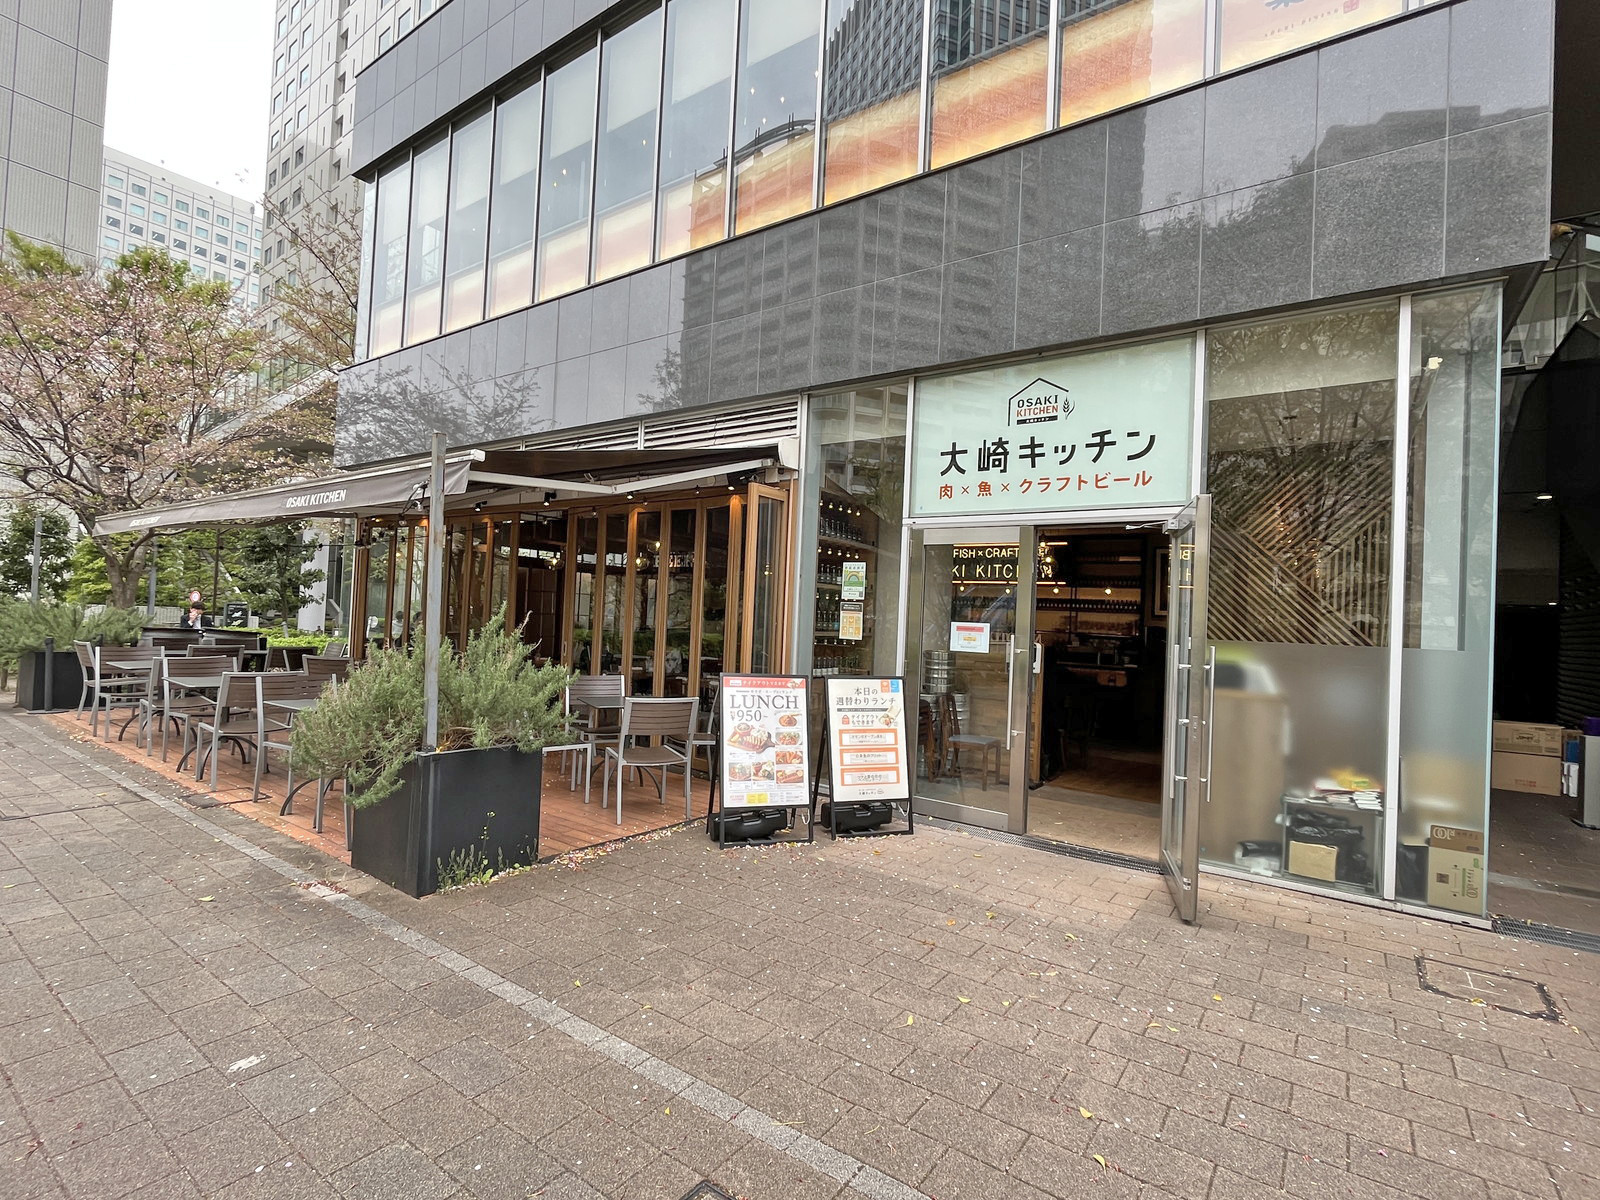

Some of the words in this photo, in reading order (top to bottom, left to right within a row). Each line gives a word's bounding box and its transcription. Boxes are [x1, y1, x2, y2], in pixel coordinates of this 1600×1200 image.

[1017, 394, 1059, 409] OSAKI
[1016, 404, 1059, 418] KITCHEN
[940, 429, 1157, 477] 大崎キッチン
[286, 494, 310, 508] OSAKI
[309, 489, 347, 506] KITCHEN
[854, 686, 879, 697] 本日の
[730, 694, 800, 710] LUNCH
[836, 696, 896, 707] 週替わりランチ
